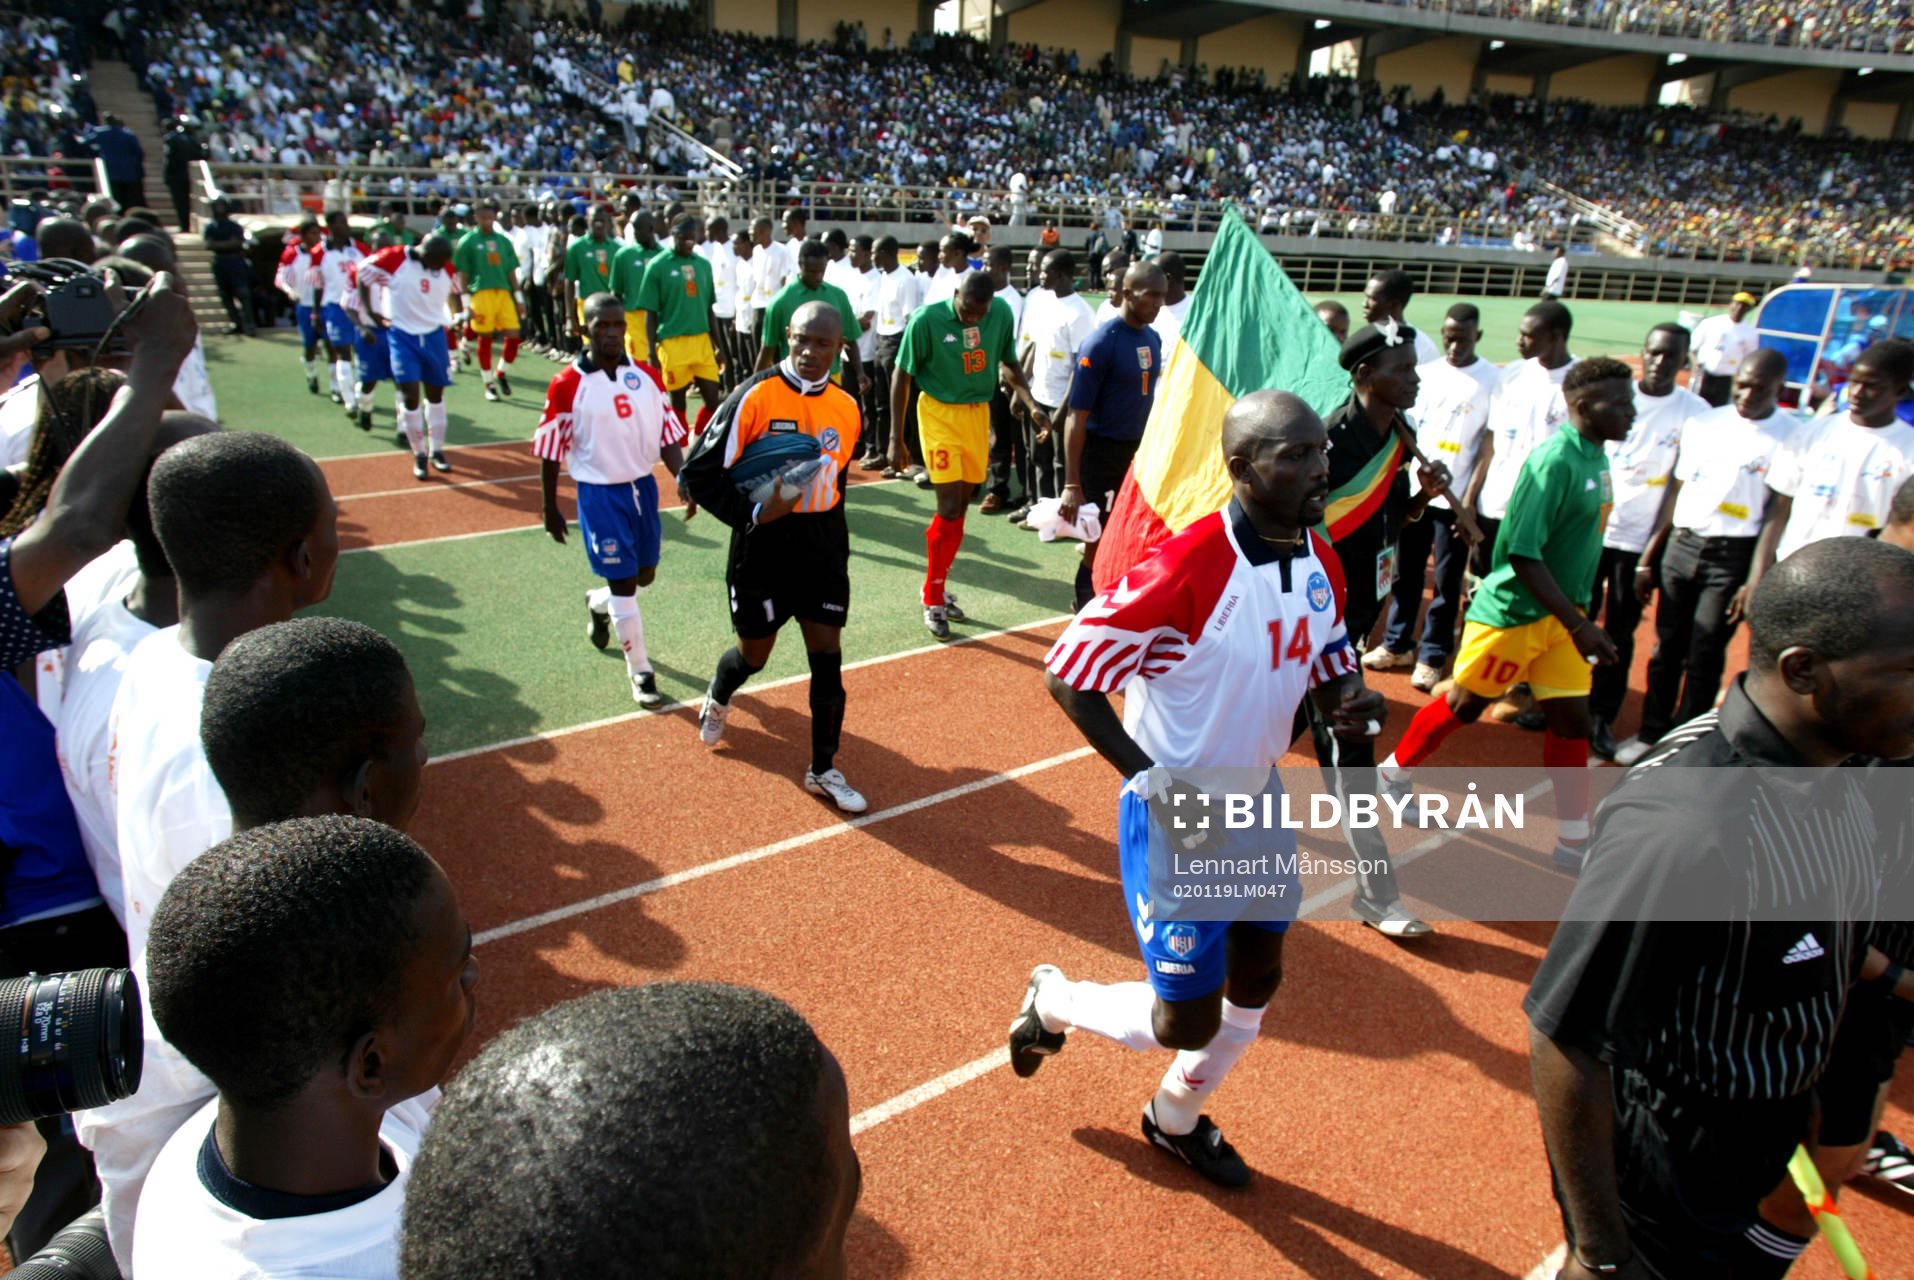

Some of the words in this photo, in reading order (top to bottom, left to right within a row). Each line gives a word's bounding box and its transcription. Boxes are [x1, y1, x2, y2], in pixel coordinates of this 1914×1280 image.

[962, 349, 986, 374] 13
[1141, 371, 1149, 396] 1
[613, 394, 633, 418] 6
[928, 450, 949, 470] 13
[1104, 489, 1115, 513] 1
[762, 598, 776, 623] 1
[1214, 594, 1240, 632] LIBERIA
[1267, 613, 1313, 672] 14
[1480, 655, 1519, 685] 10
[1156, 960, 1196, 975] LIBERIA
